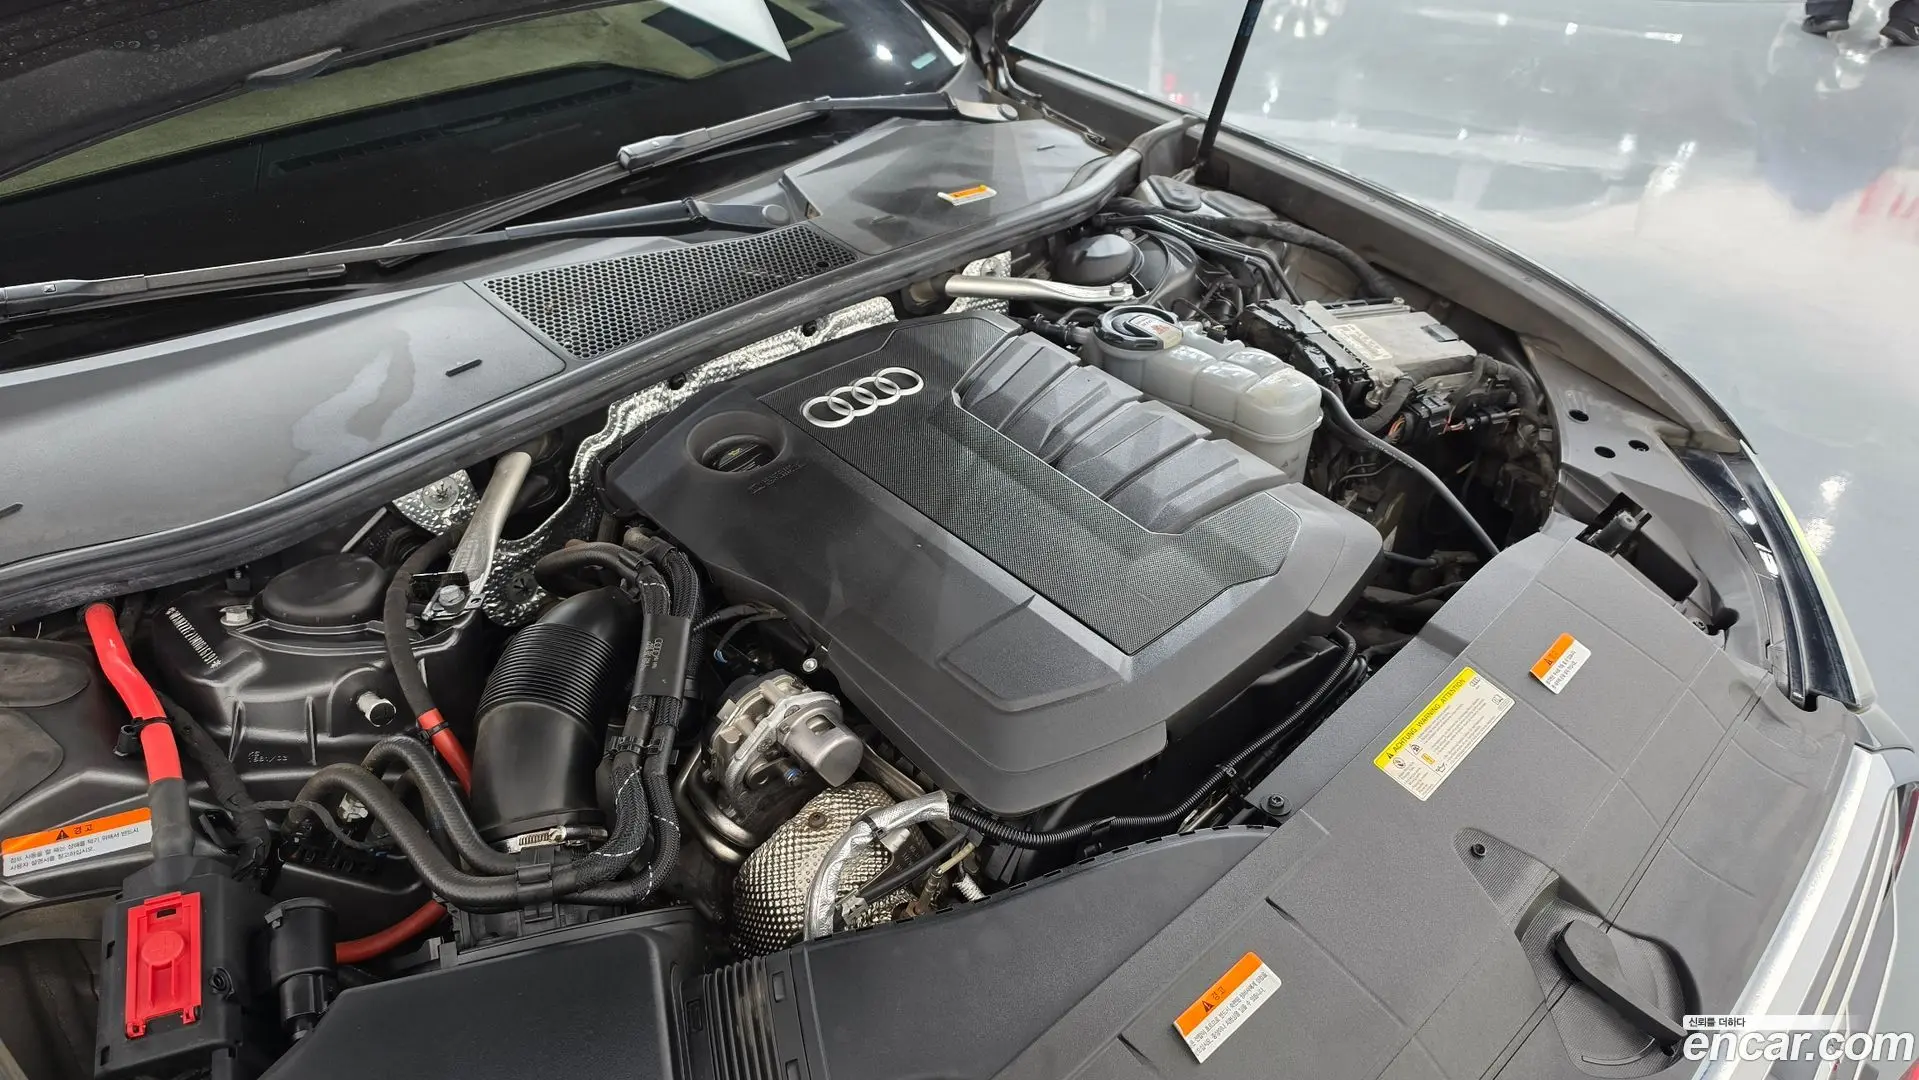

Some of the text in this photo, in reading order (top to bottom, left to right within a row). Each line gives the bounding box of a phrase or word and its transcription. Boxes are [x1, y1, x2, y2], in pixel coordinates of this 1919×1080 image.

[1392, 727, 1418, 753] ACHTUNG
[1416, 704, 1441, 729] WARNING
[1440, 678, 1466, 704] ATTENTION
